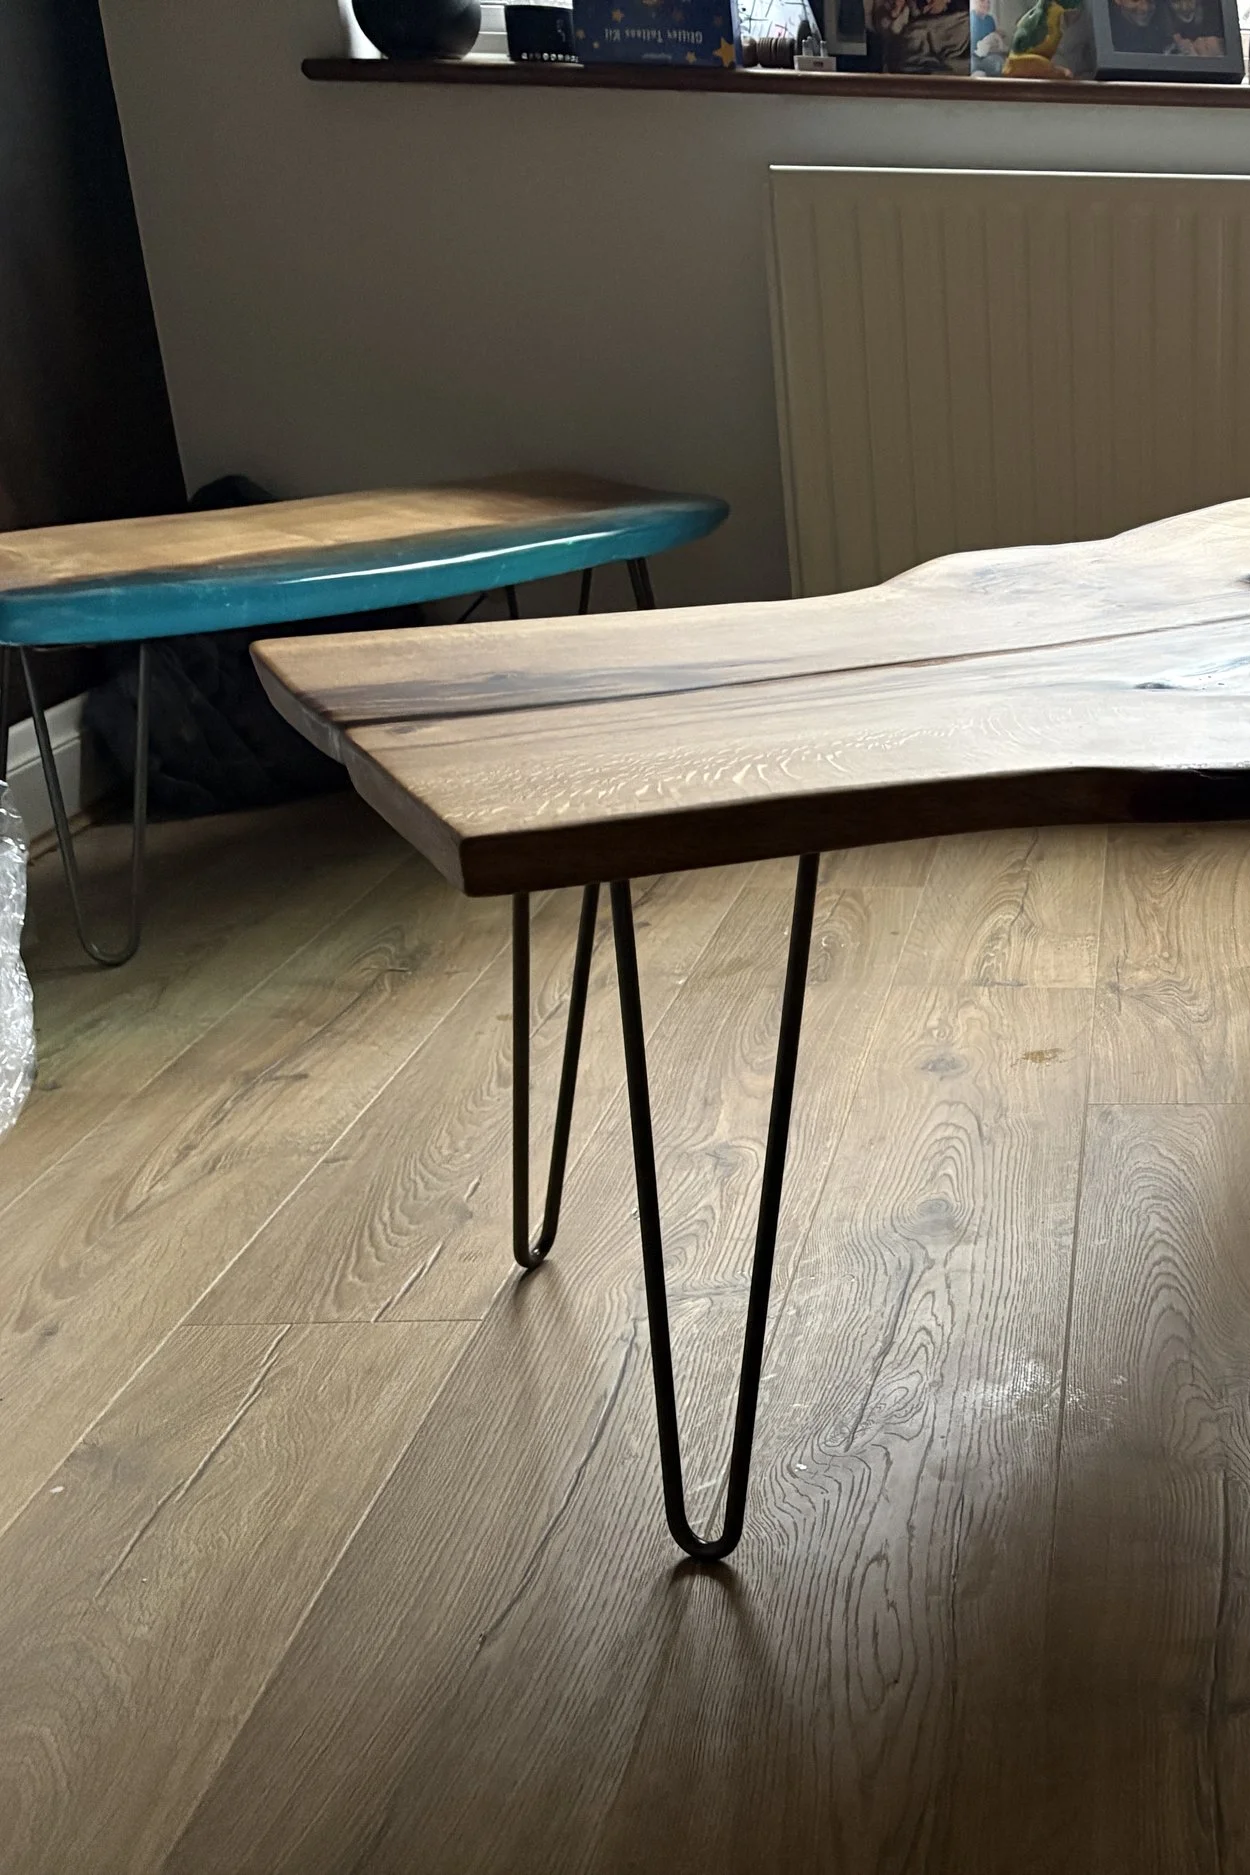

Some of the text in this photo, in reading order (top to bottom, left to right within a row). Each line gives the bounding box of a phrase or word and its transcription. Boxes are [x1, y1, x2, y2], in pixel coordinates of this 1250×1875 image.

[604, 27, 703, 44] Glitter Tattoos Kit
